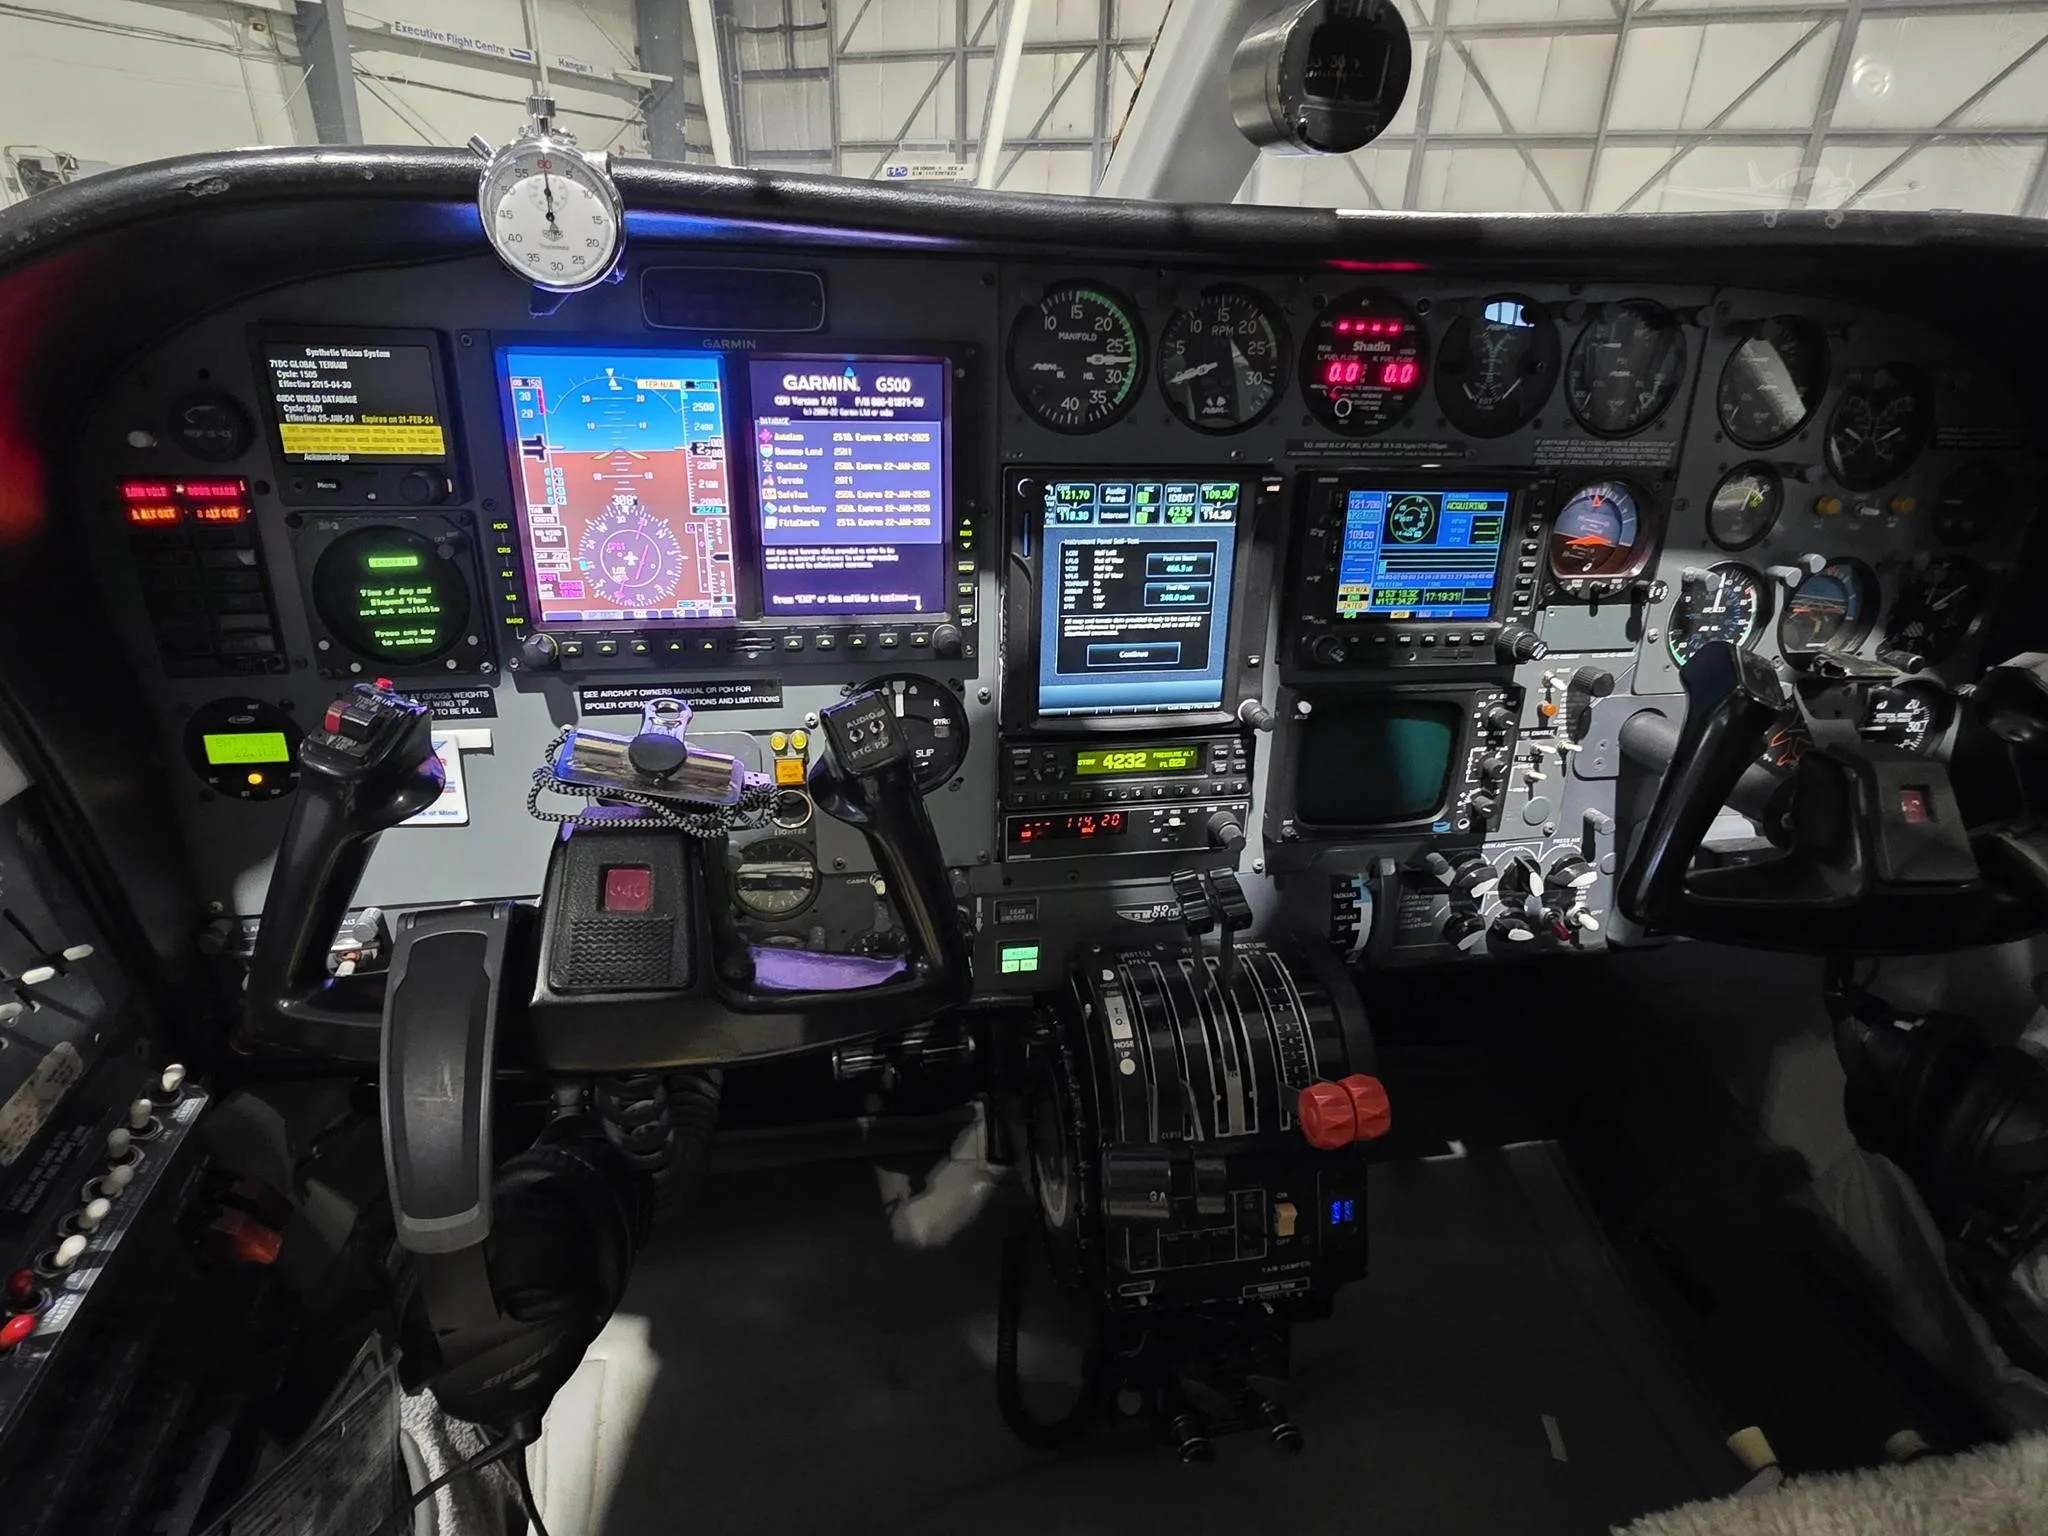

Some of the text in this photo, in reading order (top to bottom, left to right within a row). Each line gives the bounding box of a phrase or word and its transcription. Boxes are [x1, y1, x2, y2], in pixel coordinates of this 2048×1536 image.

[395, 21, 505, 55] Executive Flight Centre
[558, 58, 586, 72] Hangar
[515, 169, 529, 178] 55
[566, 170, 573, 179] 5
[582, 190, 592, 199] 10
[499, 210, 513, 220] 45
[592, 215, 603, 225] 15
[508, 234, 522, 243] 40
[586, 238, 599, 247] 20
[527, 253, 540, 262] 35
[572, 255, 585, 265] 25
[551, 262, 564, 271] 30
[1071, 305, 1083, 319] 15
[1218, 308, 1230, 322] 15
[1045, 316, 1057, 330] 10
[1094, 317, 1112, 331] 20
[1190, 320, 1202, 333] 10
[1238, 321, 1256, 333] 20
[1212, 326, 1234, 336] RPM
[1059, 332, 1097, 341] MANIFOLD
[702, 338, 757, 350] GARMIN
[1106, 339, 1124, 352] 25
[1176, 341, 1185, 355] 5
[1248, 341, 1265, 355] 25
[1352, 341, 1391, 352] Shadin
[306, 348, 390, 358] Synthetic Vision System
[290, 360, 317, 369] GLOBAL
[319, 361, 348, 369] TERRAIN
[277, 370, 298, 379] Cycle:
[1105, 370, 1121, 384] 30
[1245, 372, 1263, 385] 30
[279, 380, 351, 389] Effective 2015-04-30
[644, 381, 658, 389] TER
[783, 374, 911, 393] GARMIN G500
[322, 395, 358, 404] DATABASE
[519, 392, 531, 401] 30
[581, 395, 591, 403] 20
[792, 396, 819, 406] Version
[1089, 390, 1107, 404] 35
[692, 402, 715, 412] 2500
[1061, 397, 1079, 411] 40
[521, 409, 534, 418] 20
[285, 414, 317, 422] Effective
[361, 415, 387, 424] Expires
[855, 433, 882, 442] Expires
[805, 447, 823, 456] Land
[304, 453, 349, 462] Acknowledge
[856, 462, 882, 471] Expires
[316, 480, 337, 489] Menu
[777, 476, 804, 485] Terrain
[1061, 490, 1090, 500] 121.70
[1105, 495, 1126, 503] Panel
[1168, 494, 1195, 503] IDENT
[1204, 490, 1233, 499] 109.50
[793, 505, 827, 514] Directory
[1447, 502, 1488, 510] ACQUIRING
[1060, 511, 1089, 521] 118.30
[1168, 507, 1193, 517] 4235
[1204, 511, 1232, 520] 114.20
[360, 589, 382, 597] Time
[385, 588, 395, 596] of
[399, 588, 414, 596] day
[773, 595, 794, 604] Press
[399, 606, 440, 615] available
[420, 628, 435, 636] key
[396, 637, 432, 645] continue
[422, 691, 489, 700] GROSS WEIGHTS
[584, 690, 599, 698] SEE
[600, 689, 638, 697] AIRCRAFT
[639, 688, 672, 697] OWNERS
[674, 687, 704, 695] MANUAL
[371, 694, 395, 708] TRIM
[433, 699, 469, 708] WING TIP
[584, 702, 617, 710] SPOILER
[735, 696, 780, 704] LIMITATIONS
[933, 699, 940, 707] R
[846, 712, 876, 728] AUDIO
[915, 749, 934, 758] SLIP
[1153, 751, 1182, 759] PRESSURE
[1103, 753, 1147, 769] 4232
[1153, 904, 1169, 913] NO
[1001, 914, 1035, 922] UNLOCKED
[1134, 909, 1181, 920] SMOKIN
[1232, 942, 1268, 950] MIXTURE
[1117, 951, 1153, 962] THROTTLE
[1114, 1041, 1134, 1049] NOSE
[1150, 1191, 1167, 1202] GA
[1262, 1261, 1311, 1273] YAW DAMPER
